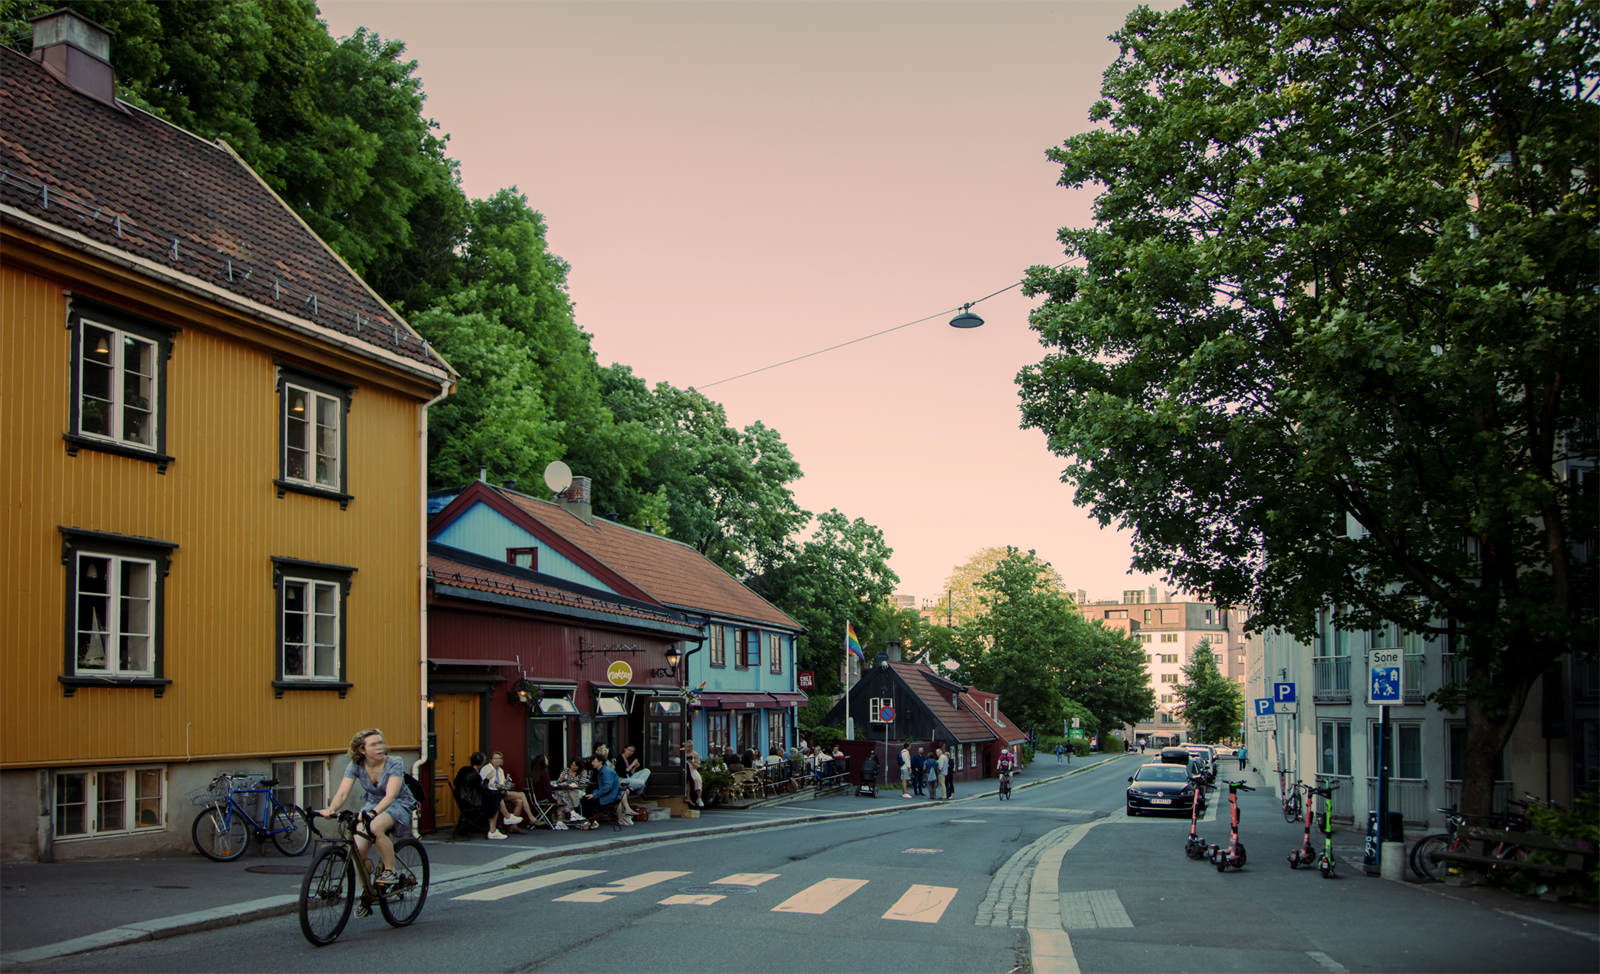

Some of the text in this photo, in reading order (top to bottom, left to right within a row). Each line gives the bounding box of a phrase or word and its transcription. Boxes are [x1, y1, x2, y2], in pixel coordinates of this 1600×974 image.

[1374, 652, 1398, 662] Sone
[1279, 685, 1291, 700] P
[1258, 700, 1269, 714] P
